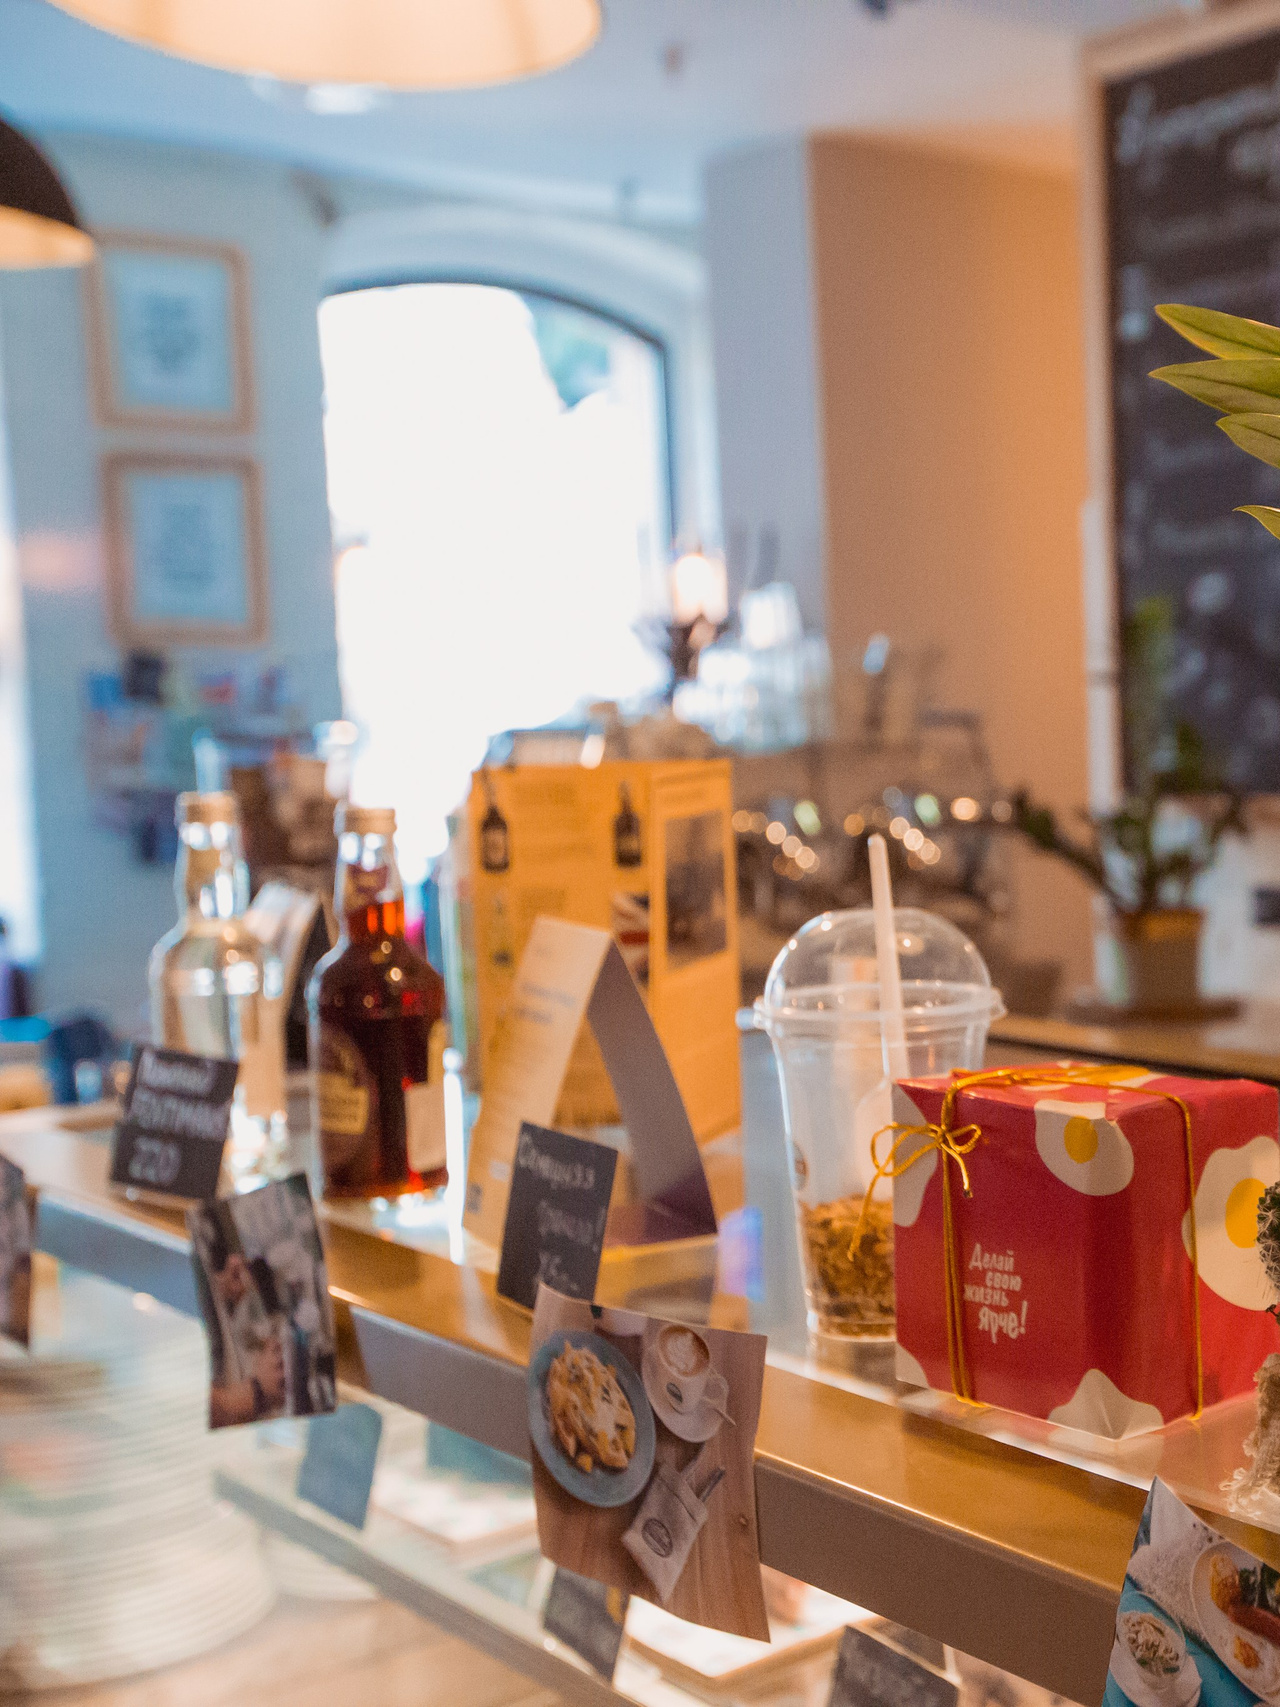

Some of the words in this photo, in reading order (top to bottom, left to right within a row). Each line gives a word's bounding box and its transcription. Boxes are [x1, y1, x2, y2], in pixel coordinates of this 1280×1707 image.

[969, 1243, 1014, 1271] Делай
[986, 1271, 1022, 1291] свою
[964, 1285, 1009, 1306] жизнь
